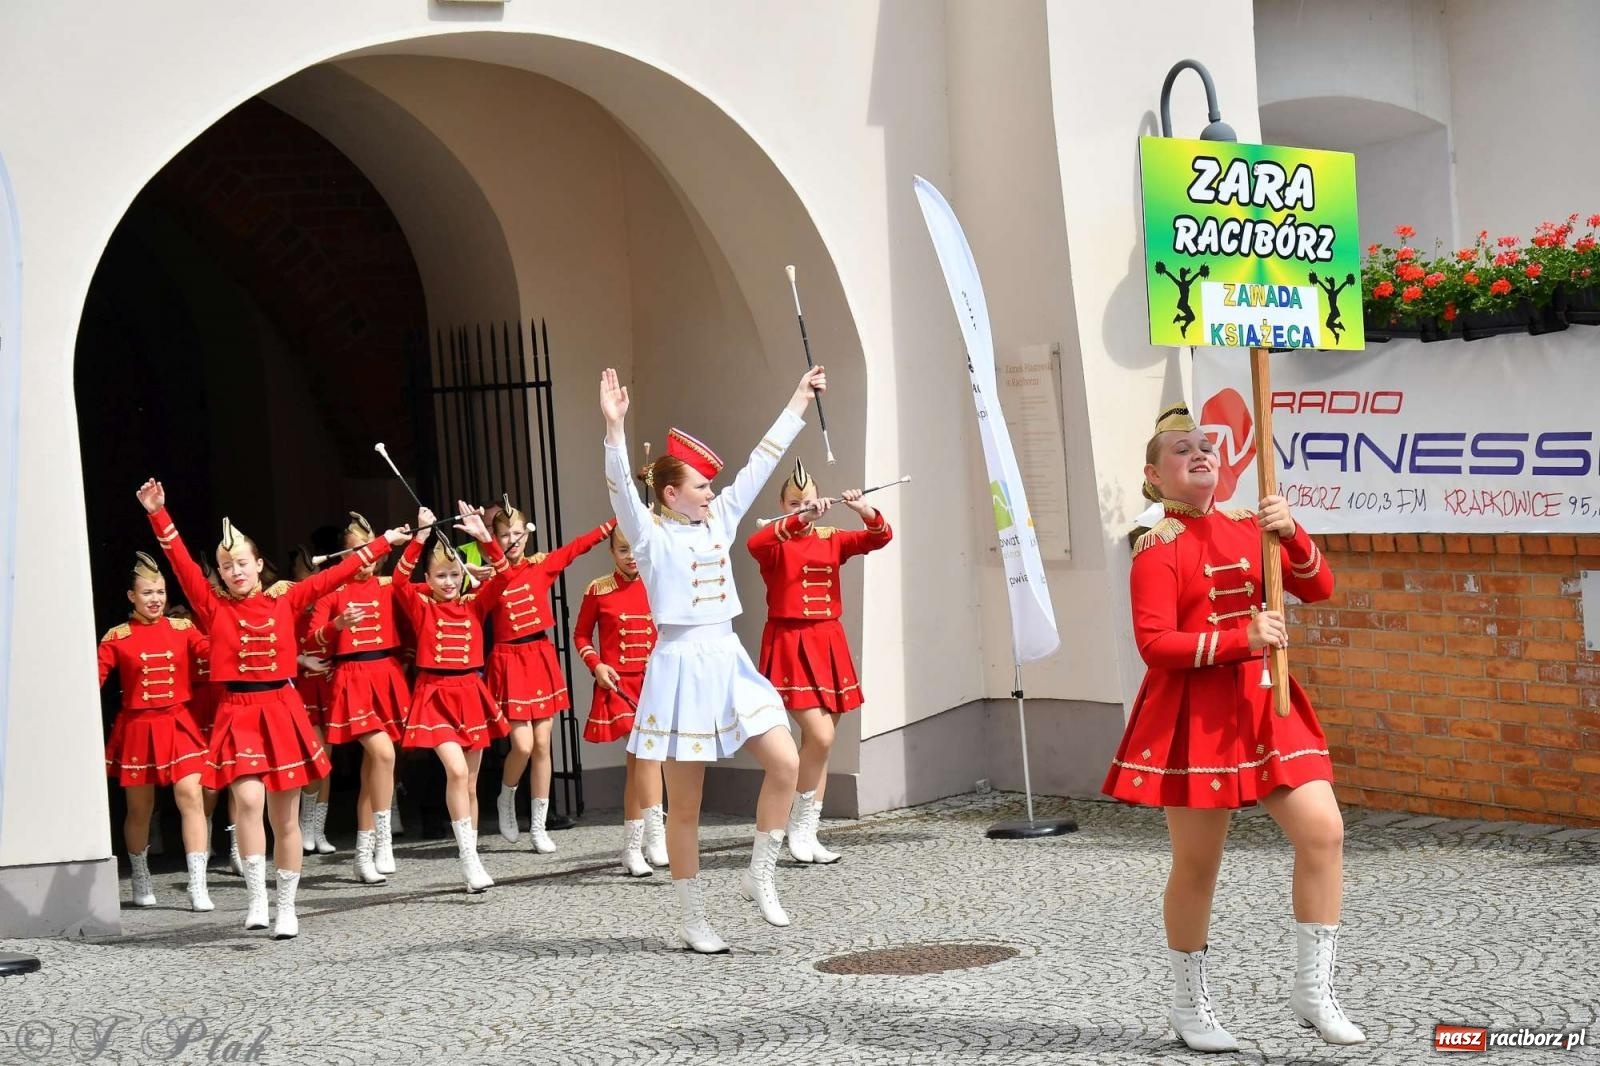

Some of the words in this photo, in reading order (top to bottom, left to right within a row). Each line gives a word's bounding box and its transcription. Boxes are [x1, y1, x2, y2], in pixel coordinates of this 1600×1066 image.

[1187, 155, 1315, 212] ZARA
[1173, 214, 1336, 263] RACIBÓRZ
[1223, 283, 1303, 309] ZAWADA
[1271, 390, 1403, 414] RADIO
[1272, 431, 1600, 476] VANESS
[1348, 491, 1392, 513] 100,3
[1397, 488, 1427, 514] FM
[1444, 488, 1564, 517] KRAPKOWICE
[1568, 495, 1600, 517] 95,
